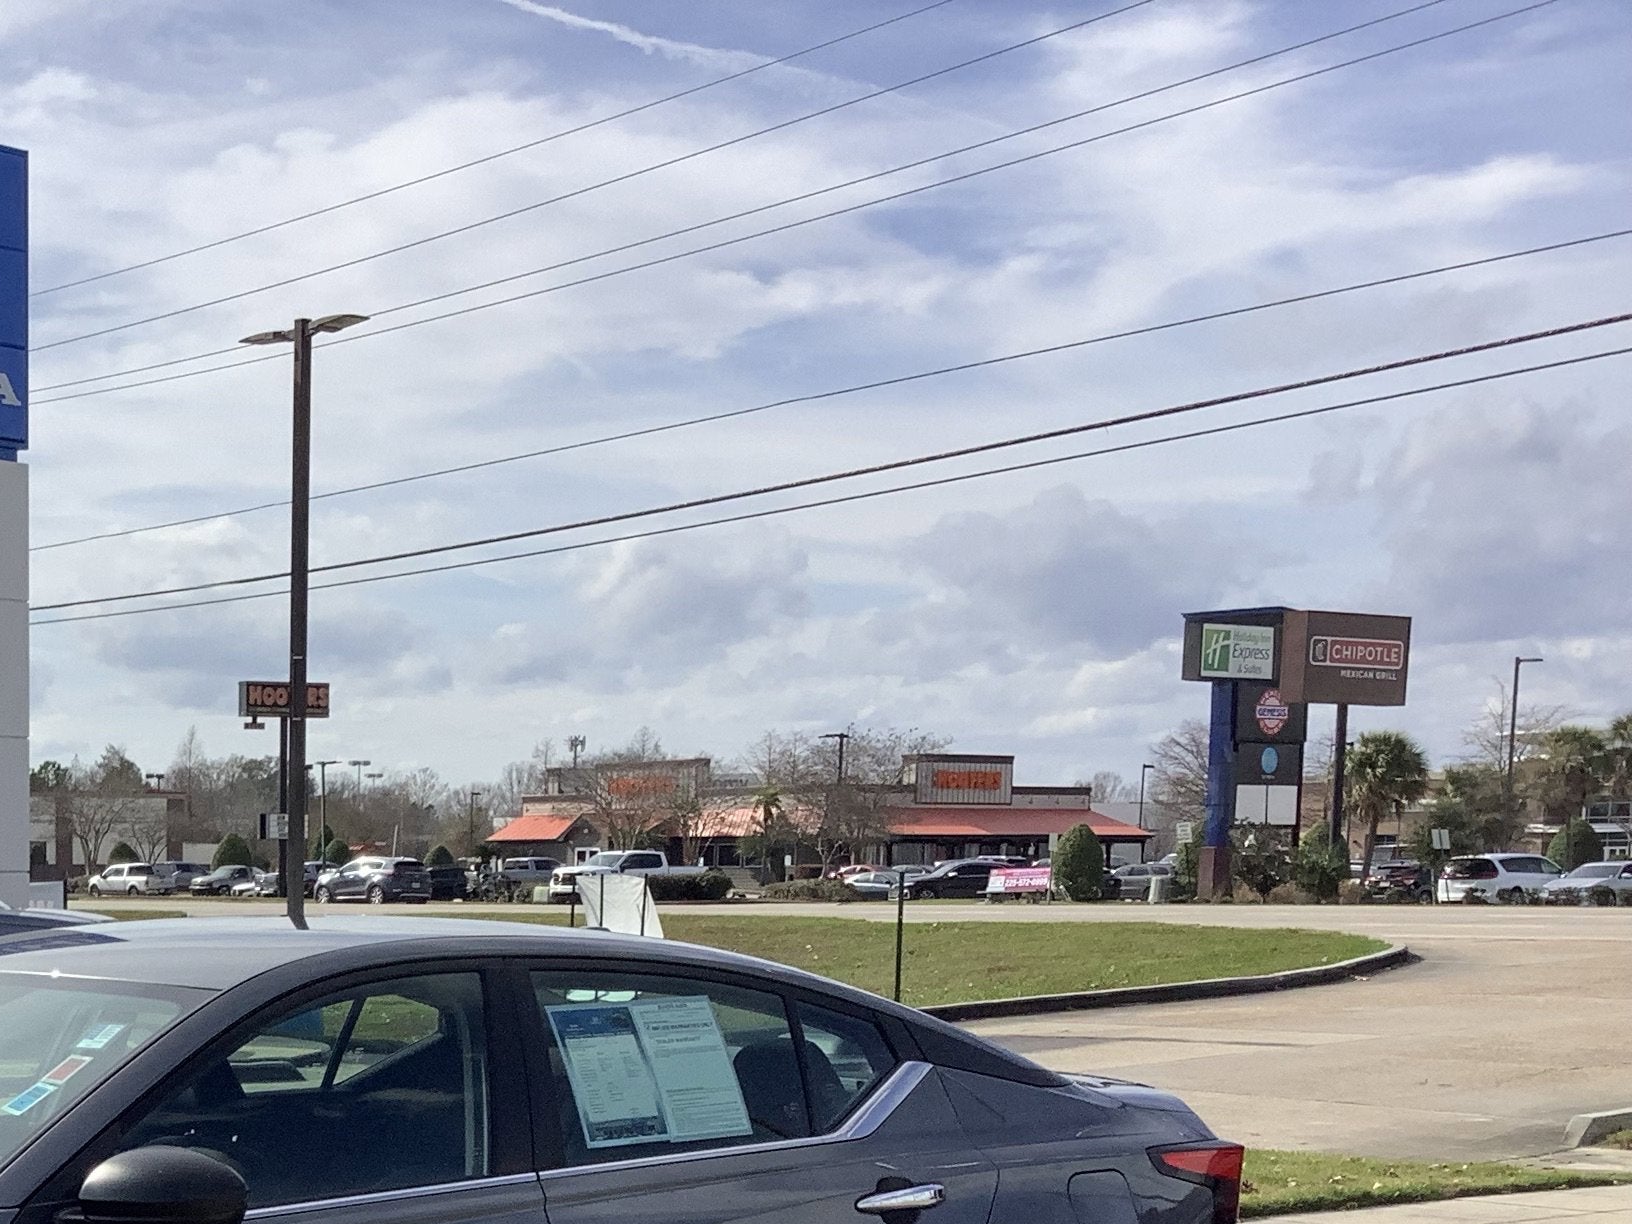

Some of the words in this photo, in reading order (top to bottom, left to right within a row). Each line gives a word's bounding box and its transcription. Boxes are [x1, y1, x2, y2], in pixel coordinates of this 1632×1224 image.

[1232, 643, 1271, 661] Express
[1332, 644, 1400, 662] CHIPOTLE
[1340, 669, 1374, 679] MEXICAN
[1375, 671, 1397, 680] GRILL
[248, 685, 329, 706] HOORS
